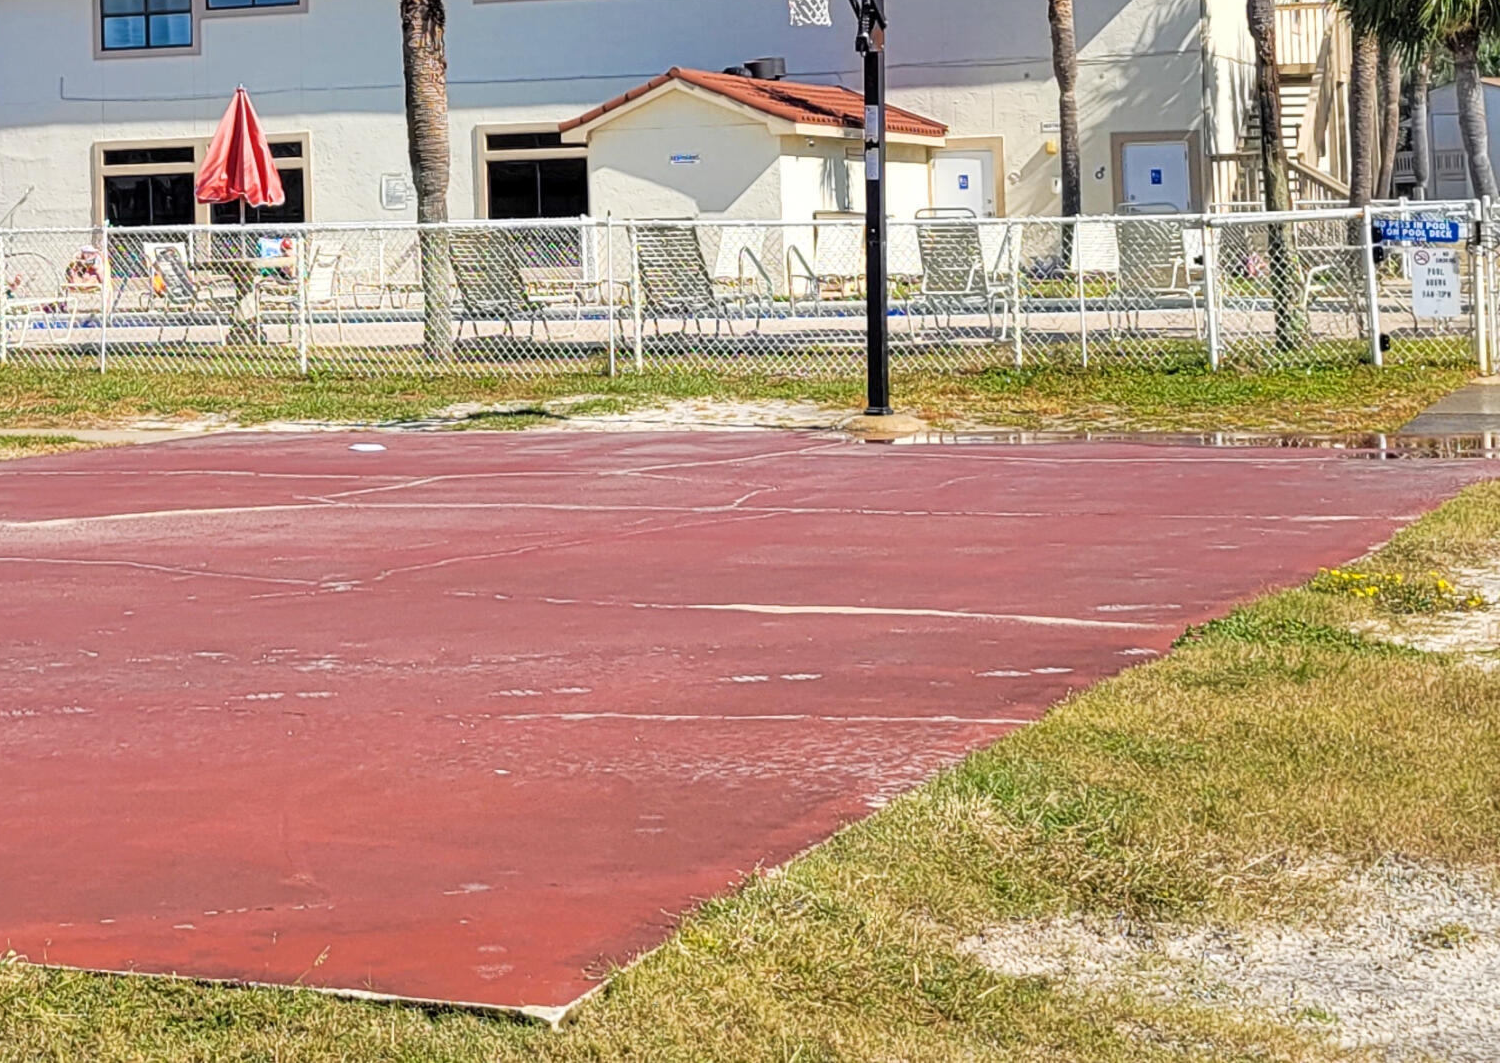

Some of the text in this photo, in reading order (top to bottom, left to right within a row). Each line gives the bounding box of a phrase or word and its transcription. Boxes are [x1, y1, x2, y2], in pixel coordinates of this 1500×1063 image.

[1413, 221, 1423, 229] IN
[1426, 222, 1450, 230] POOL
[1386, 228, 1399, 236] ON
[1402, 228, 1426, 237] POOL
[1429, 229, 1453, 238] DECK
[1427, 267, 1444, 276] POOL
